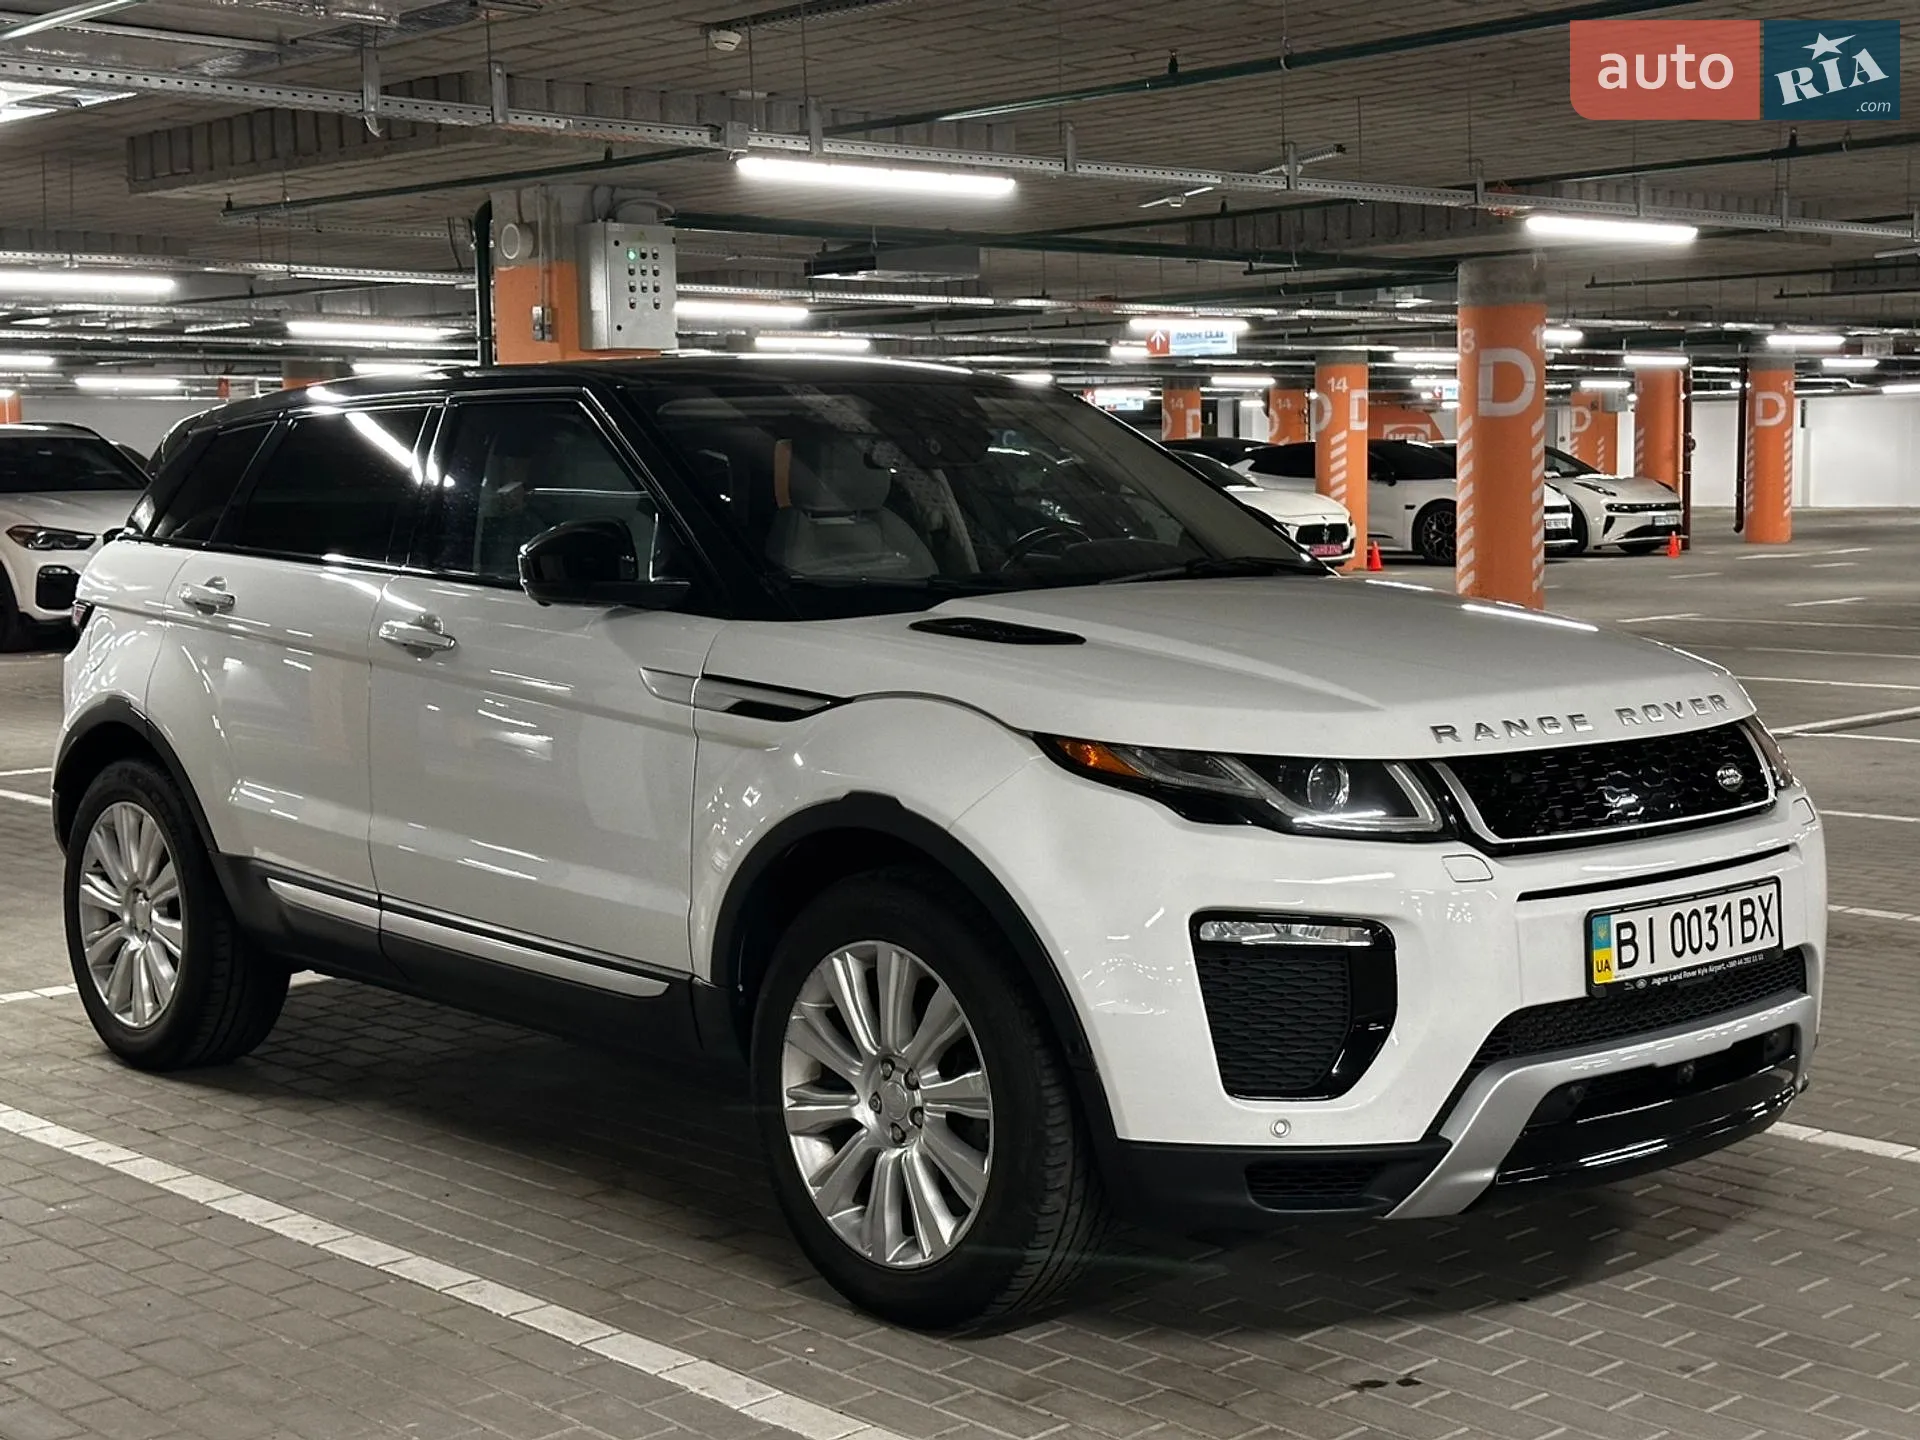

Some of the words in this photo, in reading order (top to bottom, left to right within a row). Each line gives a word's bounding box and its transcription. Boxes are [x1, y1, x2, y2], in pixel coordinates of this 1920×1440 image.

[1328, 376, 1348, 393] 14
[1478, 347, 1536, 416] D
[1571, 406, 1591, 432] D
[1755, 391, 1787, 426] D
[1429, 713, 1594, 744] RANGE
[1614, 693, 1731, 727] ROVER
[1596, 959, 1612, 973] UA
